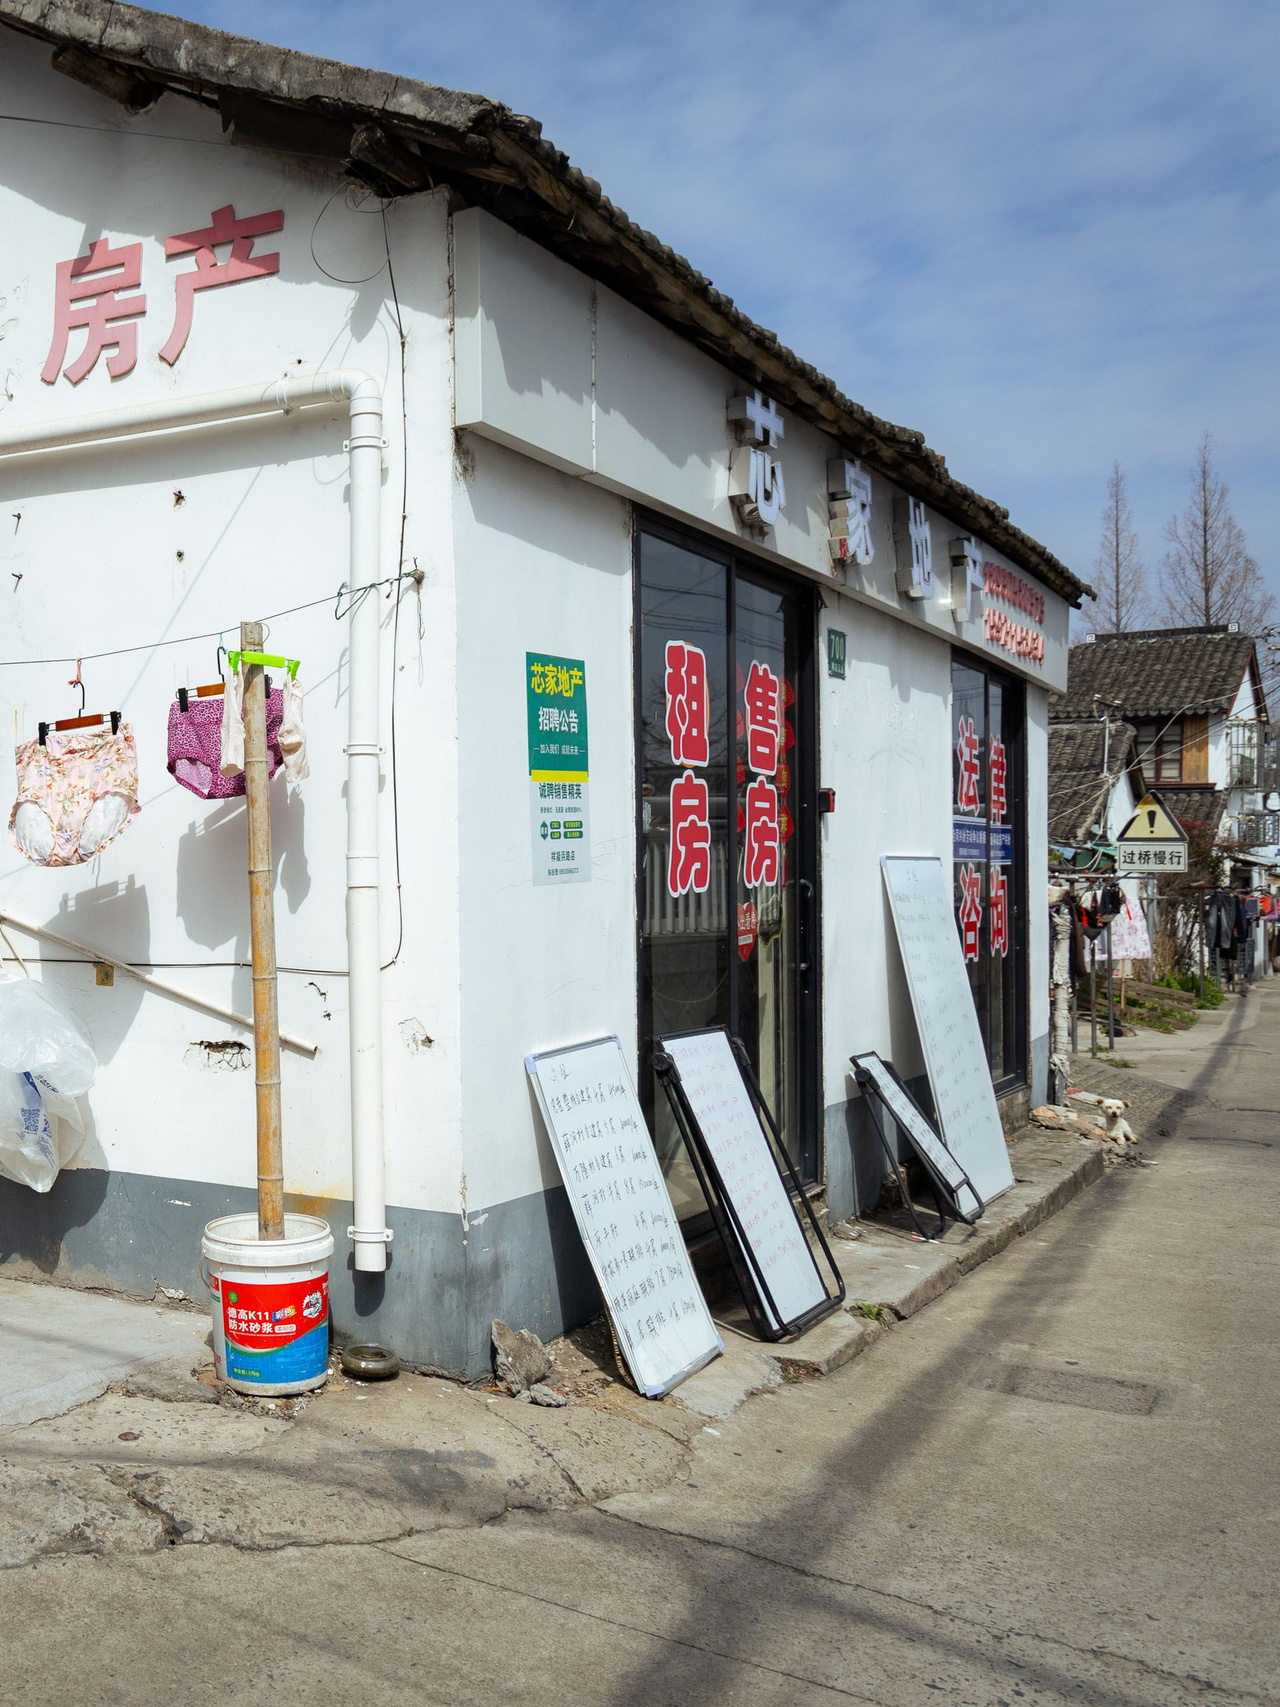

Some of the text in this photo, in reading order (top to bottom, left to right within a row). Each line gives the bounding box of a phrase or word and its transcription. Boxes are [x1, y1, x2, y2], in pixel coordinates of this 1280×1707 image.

[40, 203, 285, 387] 房产
[738, 388, 983, 622] 芯家地产
[831, 634, 844, 661] 700
[531, 662, 583, 698] 芯家地产
[539, 706, 578, 734] 招聘公告
[665, 640, 711, 898] 租房
[744, 659, 780, 889] 售房
[957, 715, 1007, 825] 法律
[539, 783, 582, 800] 诚聘销售精英
[1122, 850, 1183, 866] 过桥慢行
[959, 862, 1008, 963] 咨询
[227, 1307, 269, 1320] 德高K11
[228, 1319, 273, 1333] 防水砂浆
